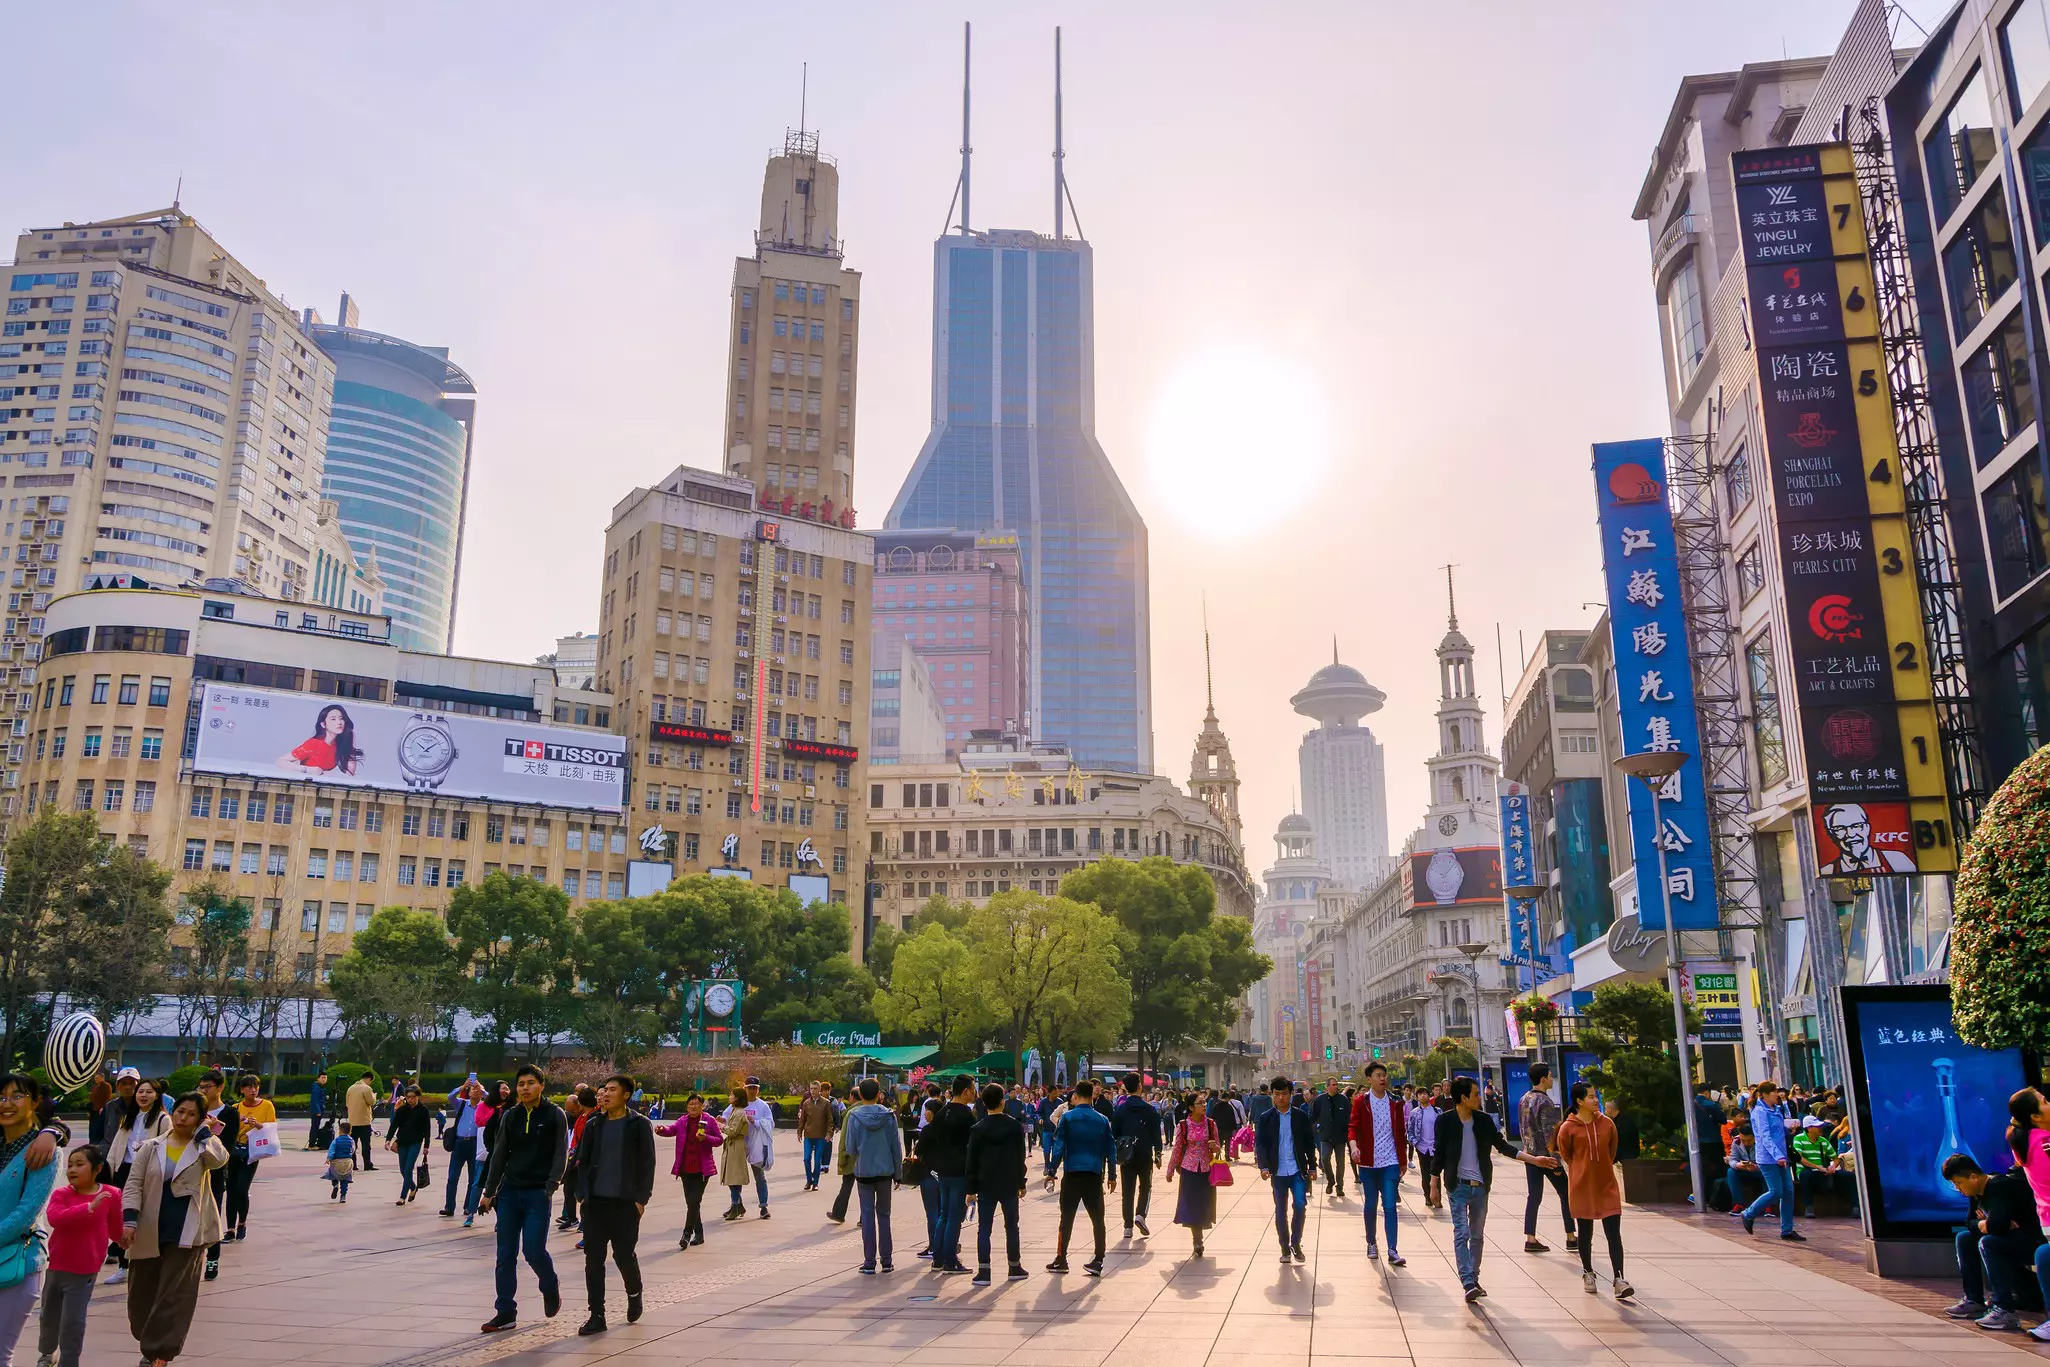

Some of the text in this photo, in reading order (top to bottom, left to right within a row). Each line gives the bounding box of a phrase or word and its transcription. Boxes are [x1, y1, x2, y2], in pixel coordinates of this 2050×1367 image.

[1752, 208, 1818, 227] 英立珠宝
[1833, 204, 1851, 230] 7
[1754, 229, 1797, 242] YINGLI
[1756, 243, 1812, 258] JEWELRY
[1846, 286, 1866, 312] 6
[1771, 351, 1838, 381] 陶瓷
[1858, 369, 1878, 396] 5
[1776, 386, 1836, 403] 精品商场
[1784, 456, 1832, 472] SHANGHAI
[1870, 458, 1892, 485] 4
[1786, 473, 1842, 490] PORCELAIN
[1788, 492, 1814, 507] EXPO
[1791, 530, 1863, 554] 珍珠城
[1792, 558, 1857, 574] PEARLS CITY
[1882, 547, 1903, 576] 3
[1894, 642, 1918, 671] 2
[1806, 656, 1880, 675] 工艺礼品
[1808, 678, 1875, 691] ART & CRAFTS
[736, 692, 746, 700] 50
[775, 698, 784, 706] 10
[734, 736, 744, 744] 32
[547, 744, 622, 766] TISSOT
[1912, 736, 1928, 766] 1
[524, 760, 549, 776] 天梭
[1866, 782, 1900, 790] Jewelers
[1874, 832, 1909, 843] KFC
[1914, 819, 1946, 849] B1
[1612, 924, 1667, 958] lily
[1698, 976, 1736, 988] 好伦哥
[818, 1030, 846, 1046] Chez
